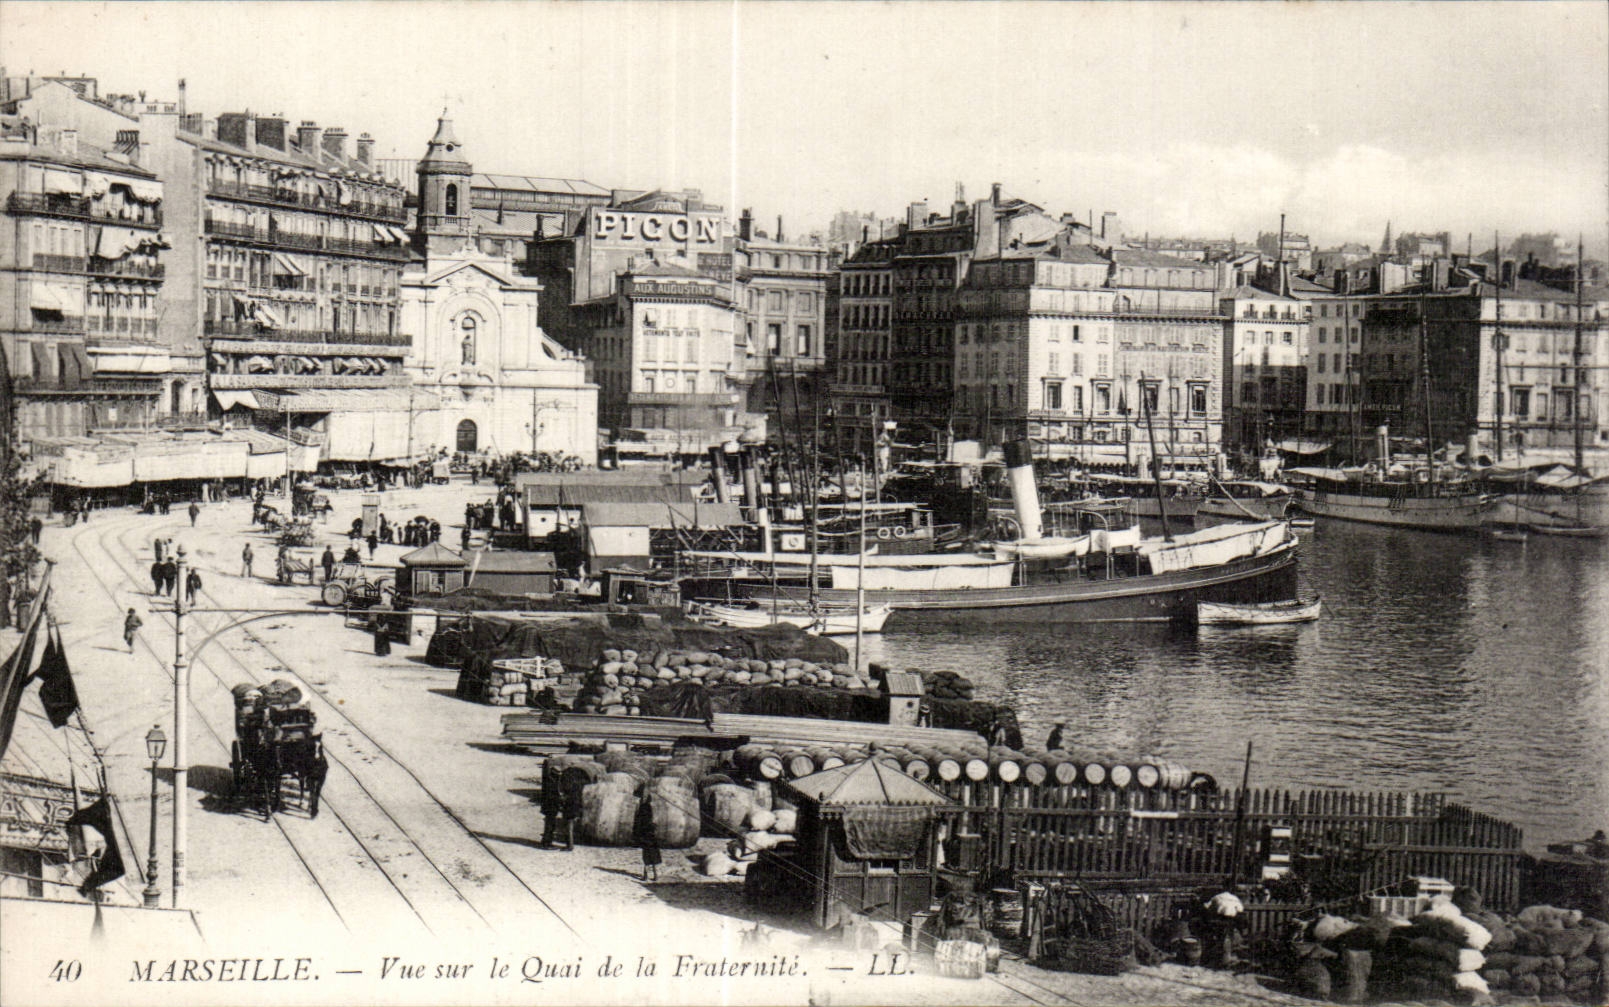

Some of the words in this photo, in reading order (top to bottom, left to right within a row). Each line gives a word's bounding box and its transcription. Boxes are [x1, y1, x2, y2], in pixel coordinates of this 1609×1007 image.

[595, 212, 721, 244] PICON
[634, 283, 654, 294] AUX
[656, 283, 713, 296] AUGUSTINS
